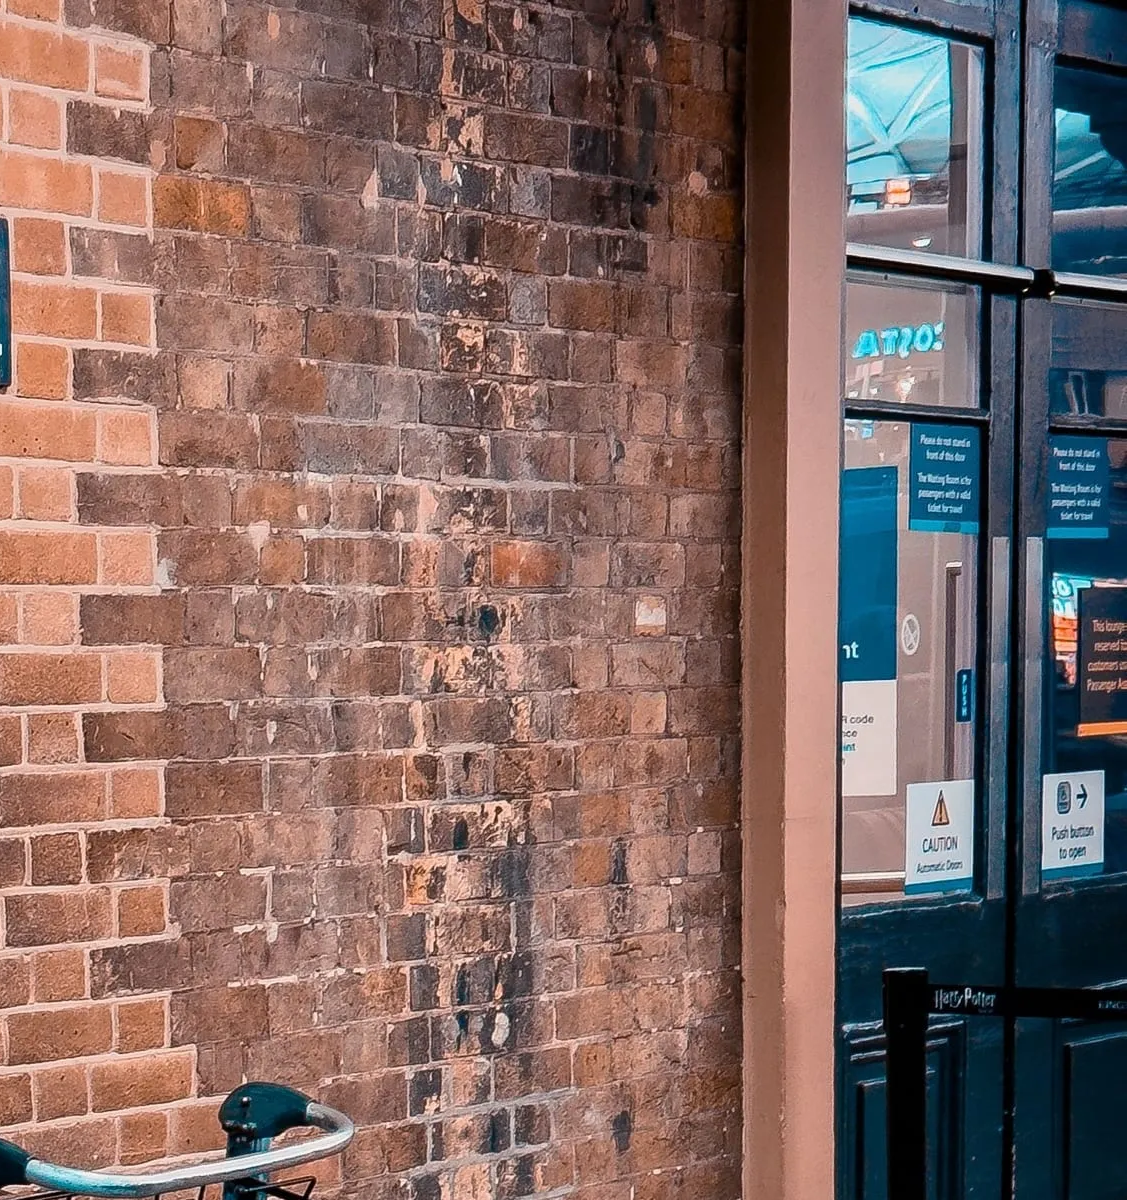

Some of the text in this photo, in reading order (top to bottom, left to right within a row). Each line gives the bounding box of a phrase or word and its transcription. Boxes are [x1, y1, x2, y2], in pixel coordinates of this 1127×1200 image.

[1092, 619, 1105, 632] This
[849, 714, 875, 725] code
[1052, 825, 1094, 840] Push button
[922, 836, 958, 853] CAUTION
[1059, 846, 1087, 861] to open
[935, 987, 996, 1009] Harry Potter
